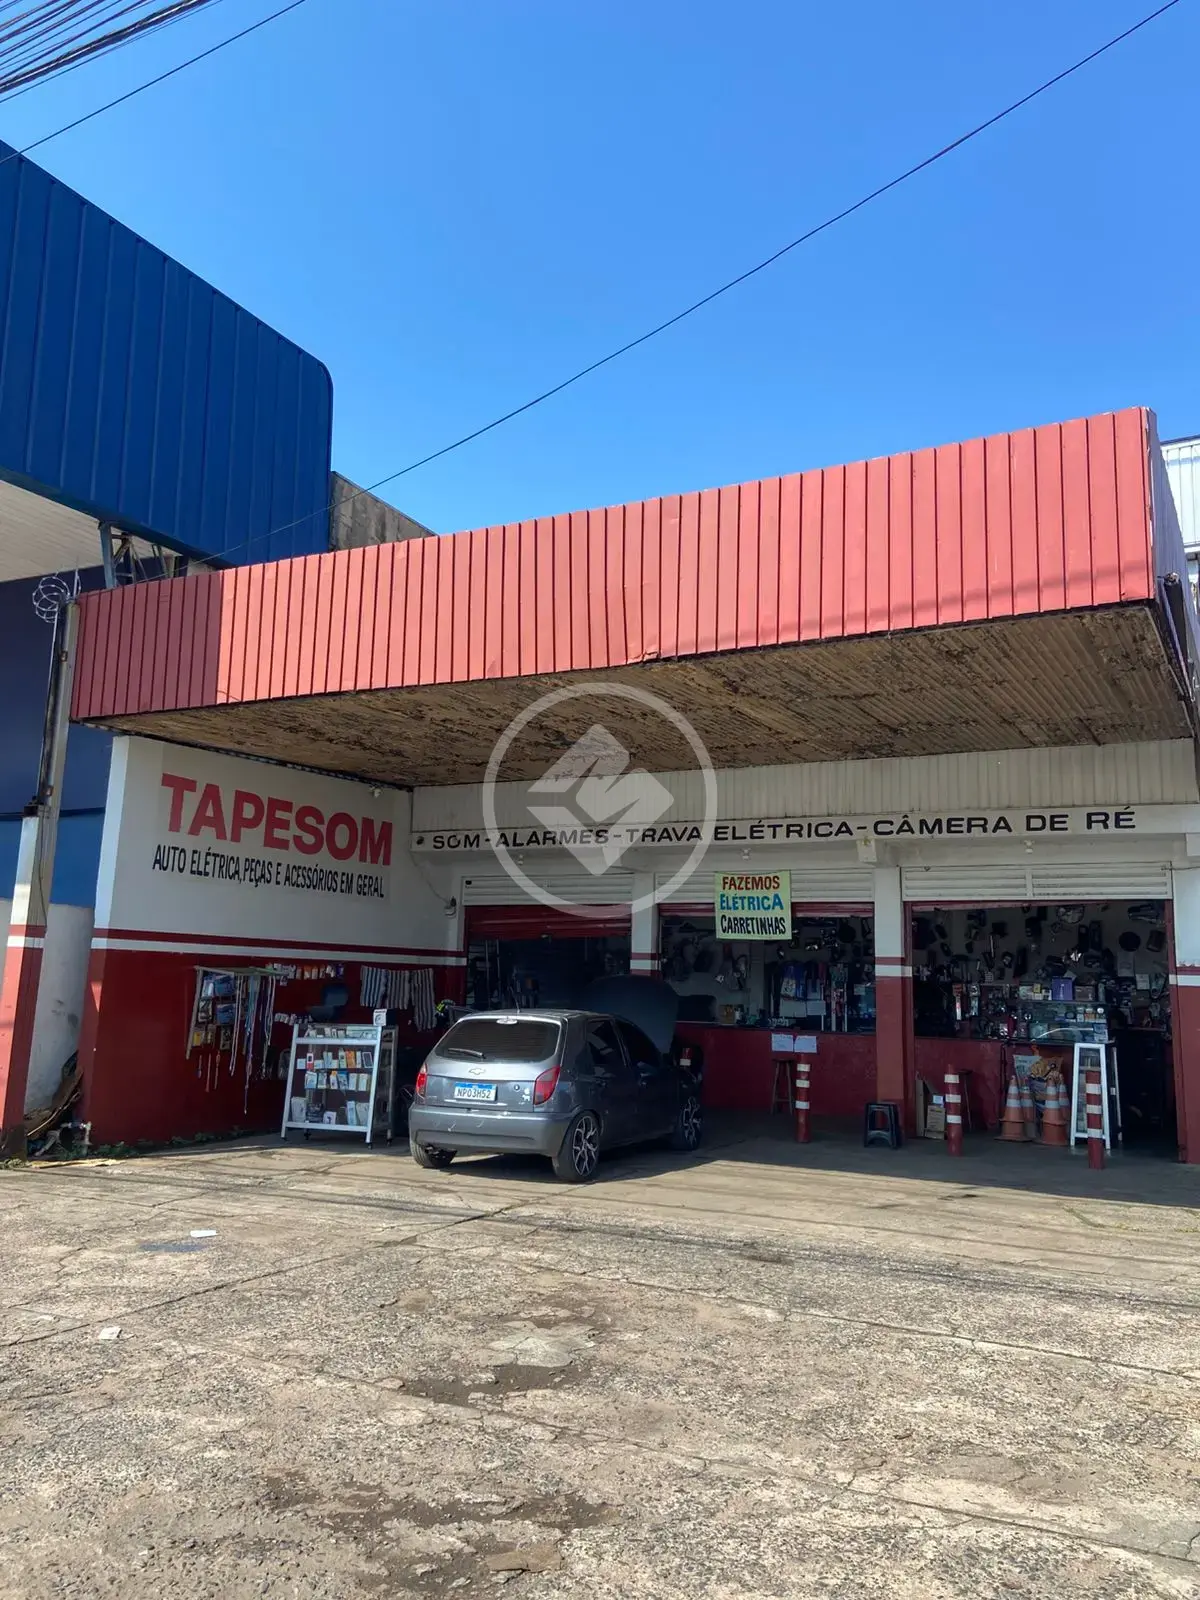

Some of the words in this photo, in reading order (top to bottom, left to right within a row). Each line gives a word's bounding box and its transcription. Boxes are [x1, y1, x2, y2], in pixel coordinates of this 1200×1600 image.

[161, 773, 393, 866] TAPESOM
[1025, 814, 1069, 832] DE
[1086, 806, 1137, 830] RÉ
[152, 844, 187, 873] AUTO
[275, 862, 282, 886] E
[283, 864, 339, 893] ACESSÓRIOS
[340, 872, 354, 894] EM
[356, 874, 384, 898] GERAL
[722, 875, 780, 891] FAZEMOS
[720, 893, 784, 911] ELÉTRICA
[720, 914, 786, 935] CARRETINHAS
